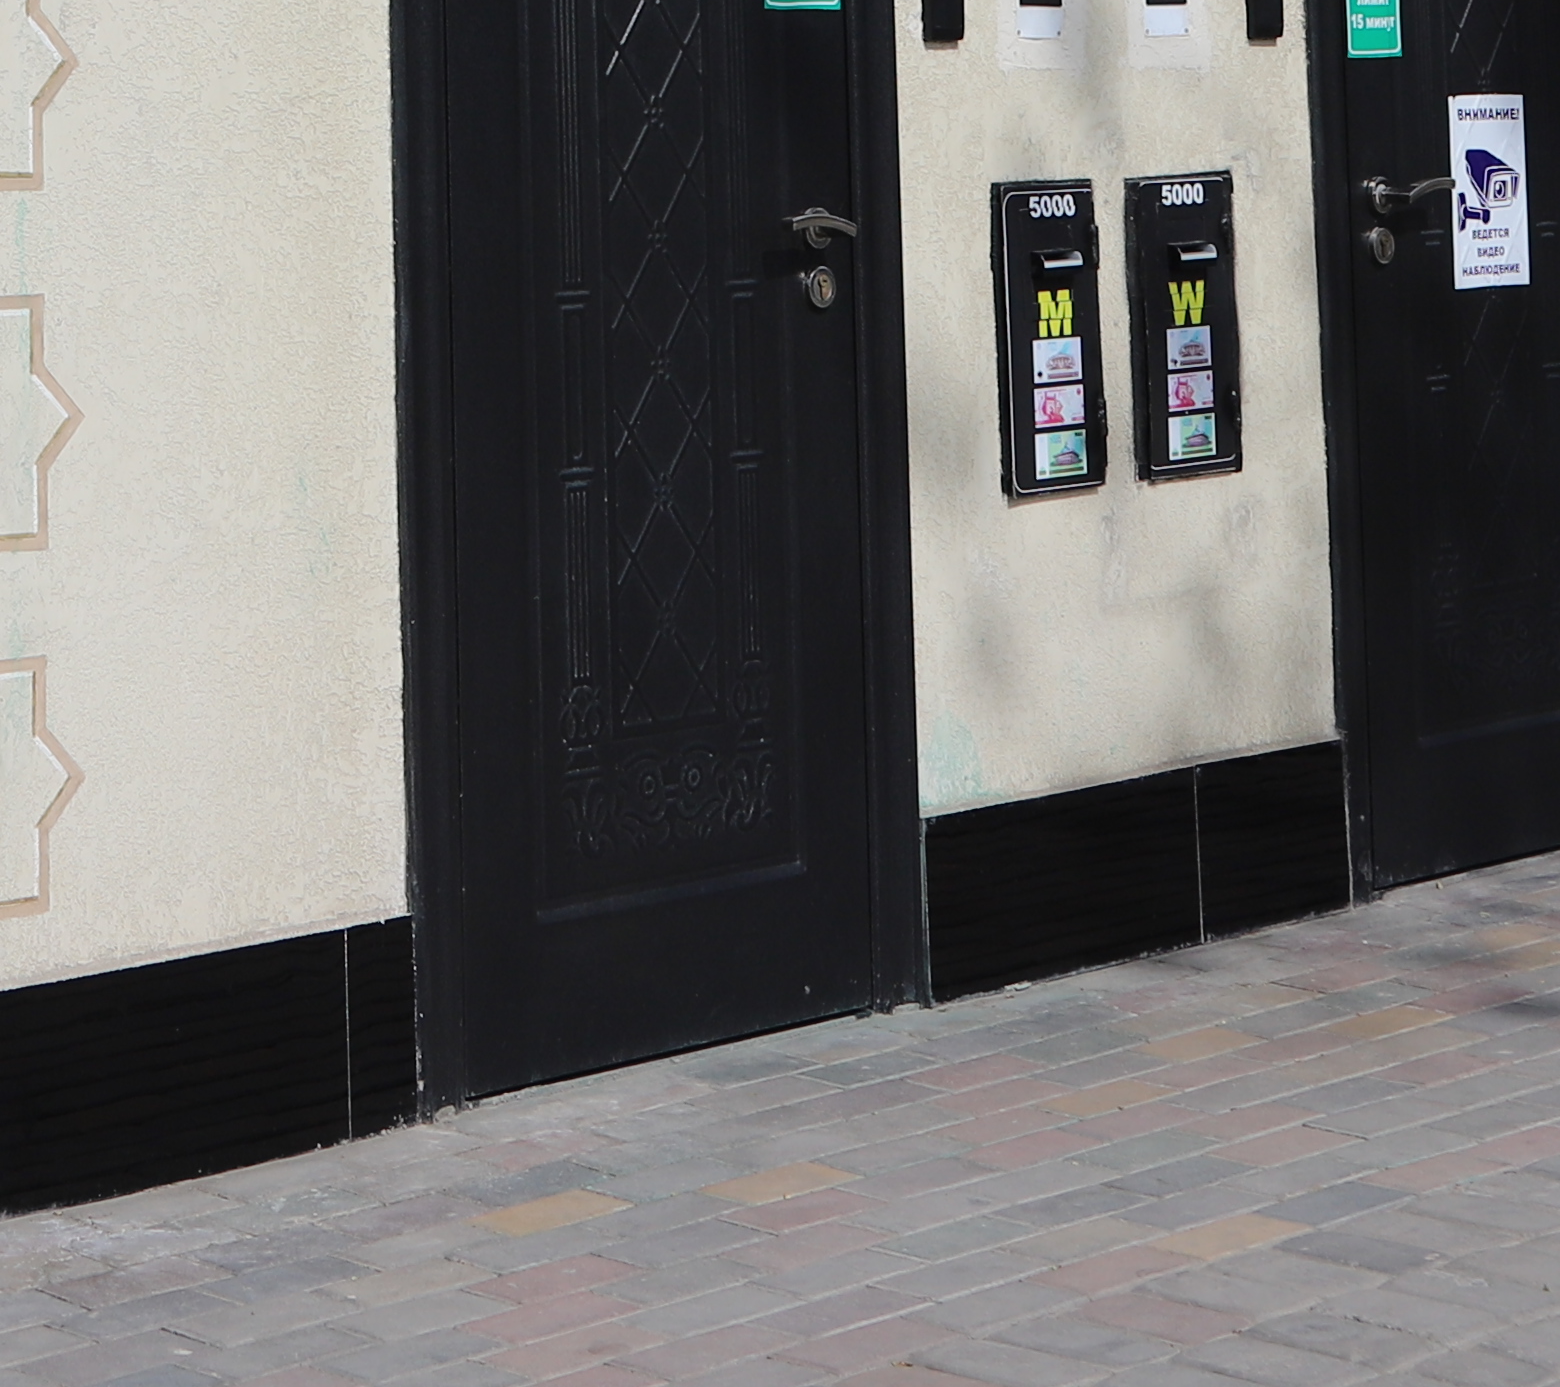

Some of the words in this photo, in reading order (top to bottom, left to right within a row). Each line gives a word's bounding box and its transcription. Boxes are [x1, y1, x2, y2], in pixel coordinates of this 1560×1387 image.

[1350, 13, 1364, 29] 15
[1457, 107, 1520, 121] ВНИМАНИЕ!
[1161, 183, 1204, 206] 5000
[1029, 194, 1076, 218] 5000
[1471, 228, 1510, 240] ВЕДЕТСЯ
[1477, 246, 1505, 258] ВИДЕО
[1462, 263, 1521, 277] НАБЛЮДЕНИЕ
[1168, 280, 1205, 326] W
